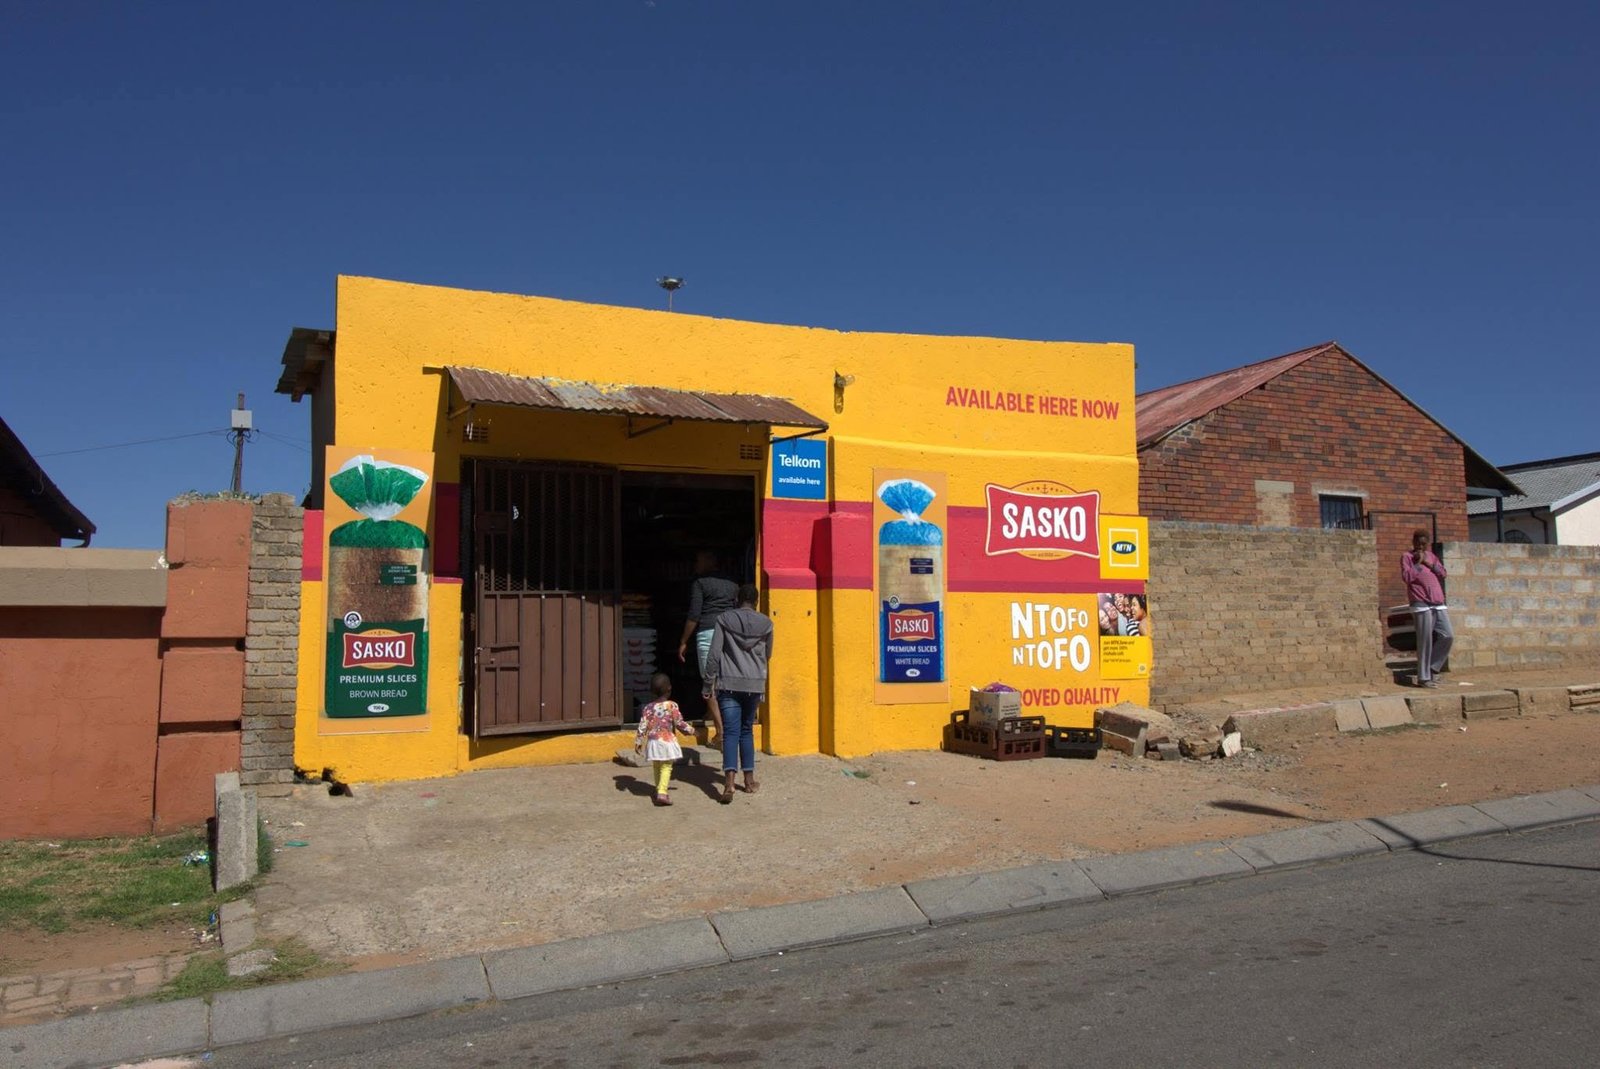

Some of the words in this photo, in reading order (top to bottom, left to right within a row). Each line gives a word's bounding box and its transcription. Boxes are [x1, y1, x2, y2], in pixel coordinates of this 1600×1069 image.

[946, 386, 1035, 413] AVAILABLE
[1039, 395, 1078, 417] HERE
[1082, 399, 1120, 420] NOW
[779, 454, 821, 469] Telkom
[778, 477, 806, 485] available
[806, 477, 821, 486] here
[1002, 502, 1087, 543] SASKO
[1116, 543, 1133, 552] MTN
[894, 618, 929, 634] SASKO
[1011, 602, 1089, 639] NTOFO
[352, 640, 406, 660] SASKO
[887, 645, 917, 653] PREMIUM
[1013, 634, 1091, 672] NTOFO
[895, 657, 911, 665] WHITE
[912, 657, 930, 665] BREAD
[339, 675, 384, 684] PREMIUM
[387, 674, 417, 683] SLICES
[349, 690, 379, 698] BROWN
[381, 689, 408, 697] BREAD
[1020, 688, 1060, 707] OVED
[1064, 687, 1120, 706] QUALITY
